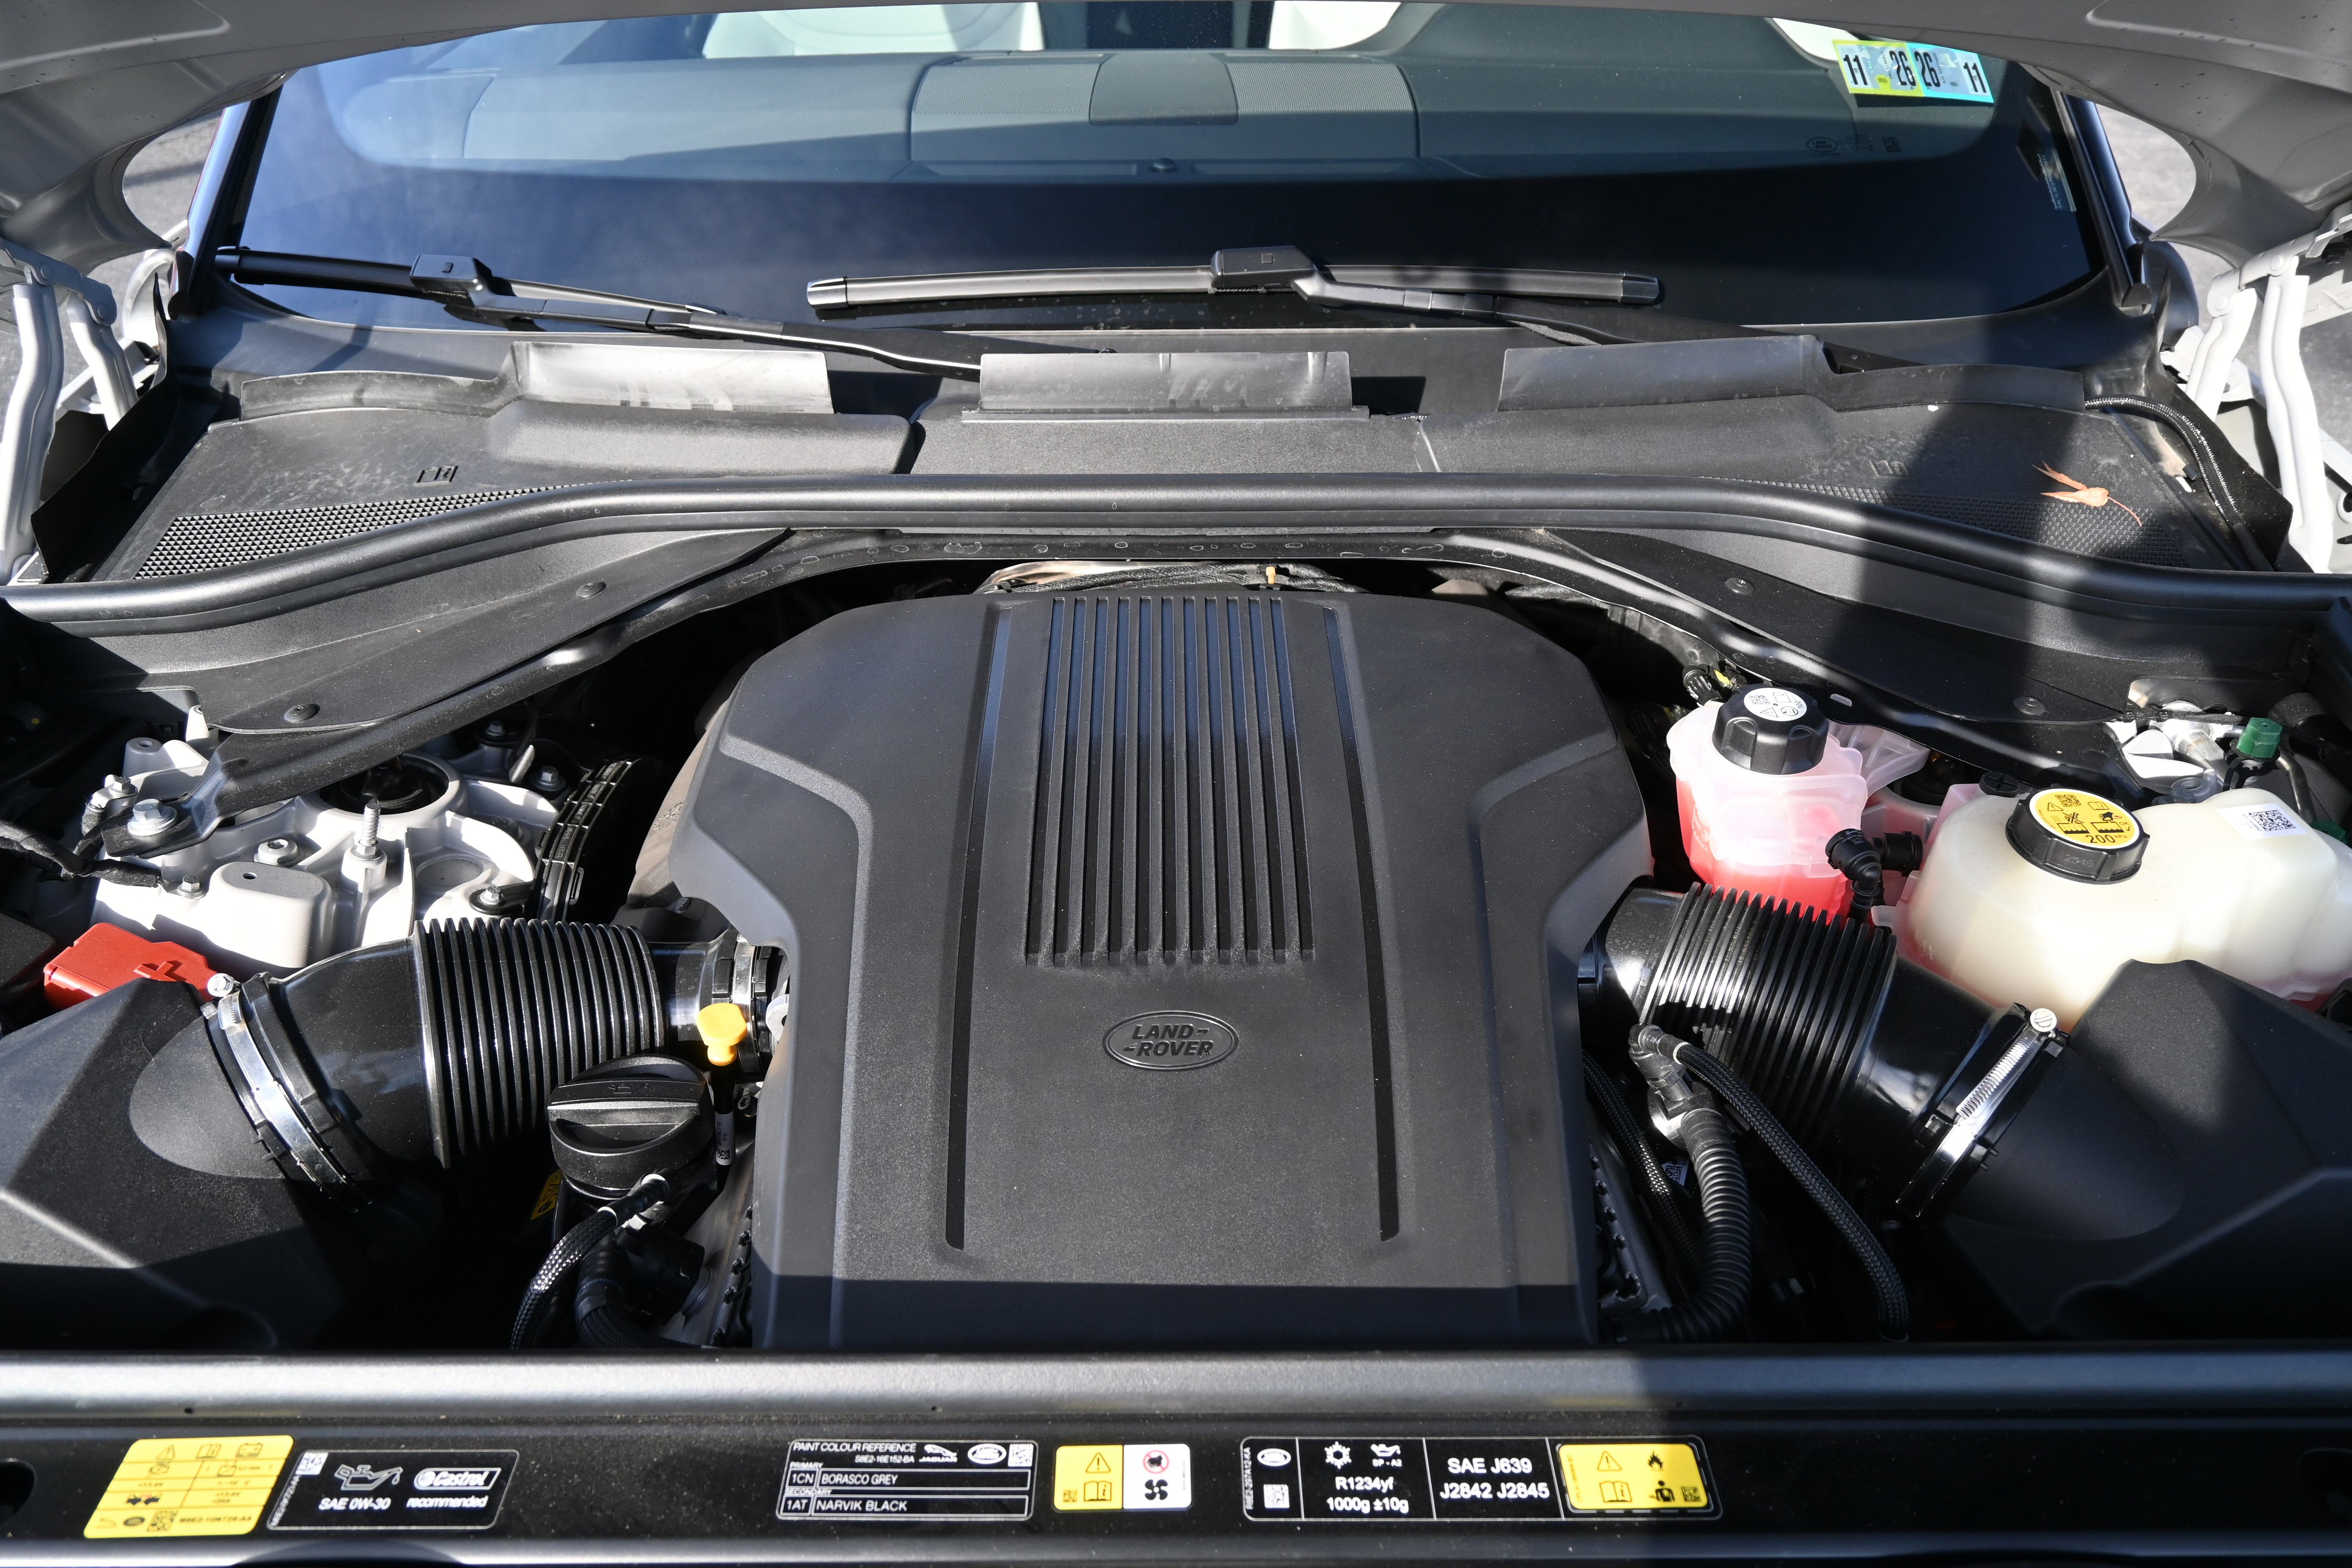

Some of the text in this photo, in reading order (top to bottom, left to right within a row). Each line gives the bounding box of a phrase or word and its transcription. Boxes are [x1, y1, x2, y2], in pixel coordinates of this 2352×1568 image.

[1843, 54, 1868, 85] 11
[1889, 50, 1916, 86] 26
[1914, 51, 1940, 87] 26
[1963, 62, 1987, 93] 11
[2085, 835, 2115, 843] 200
[1132, 1024, 1194, 1039] LAND
[1136, 1040, 1214, 1056] ROVER
[793, 1443, 916, 1453] PAINT COLOUR REFERENCE
[1447, 1457, 1532, 1473] SAE J639
[433, 1471, 489, 1486] Castrol
[792, 1473, 898, 1485] 1CN BORASCO GREY
[1335, 1476, 1394, 1493] R1234yf
[1440, 1483, 1550, 1499] J2842 J2845
[319, 1498, 391, 1510] SAE 0W-30
[406, 1495, 489, 1508] recommended
[787, 1500, 907, 1511] 1AT NARVIK BLACK
[1326, 1497, 1410, 1514] 1000g ±10g
